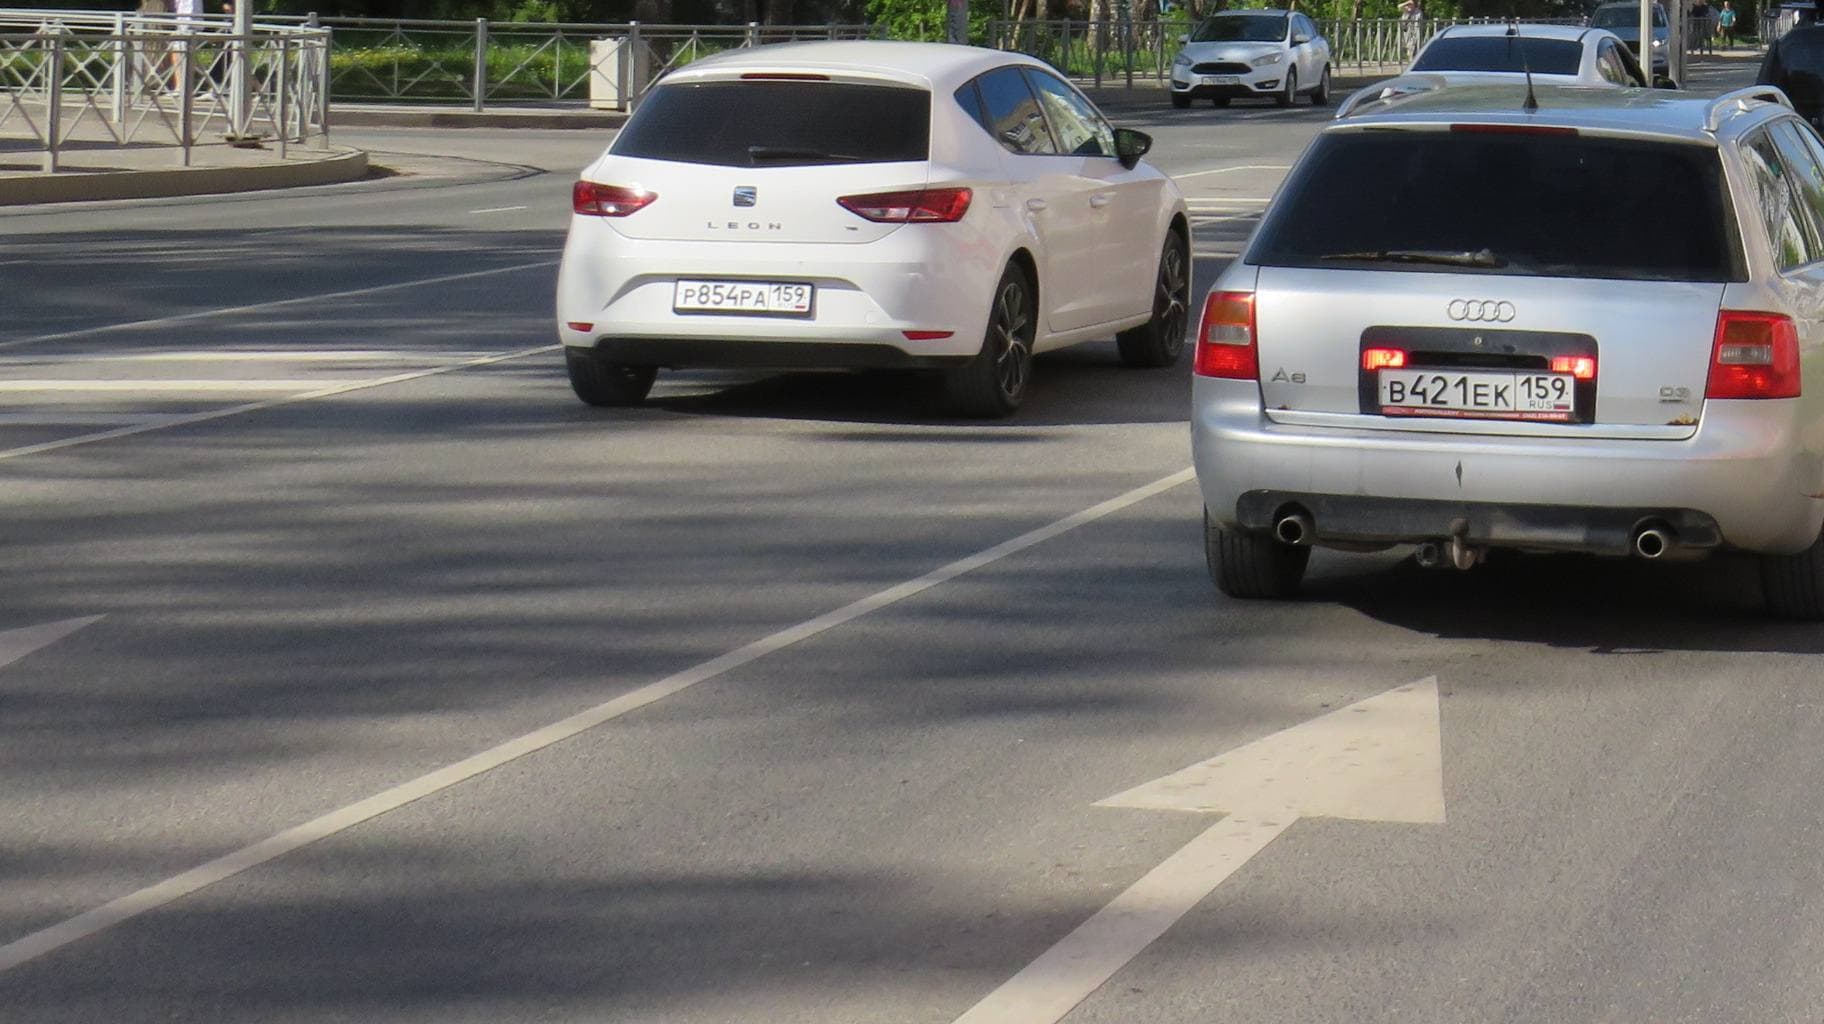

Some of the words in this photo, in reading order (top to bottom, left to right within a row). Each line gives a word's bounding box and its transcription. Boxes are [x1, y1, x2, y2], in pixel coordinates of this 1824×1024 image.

[707, 221, 782, 230] LEON
[773, 285, 805, 303] 159
[1271, 366, 1306, 384] A6
[1520, 376, 1567, 400] 159
[1529, 400, 1553, 409] RUS
